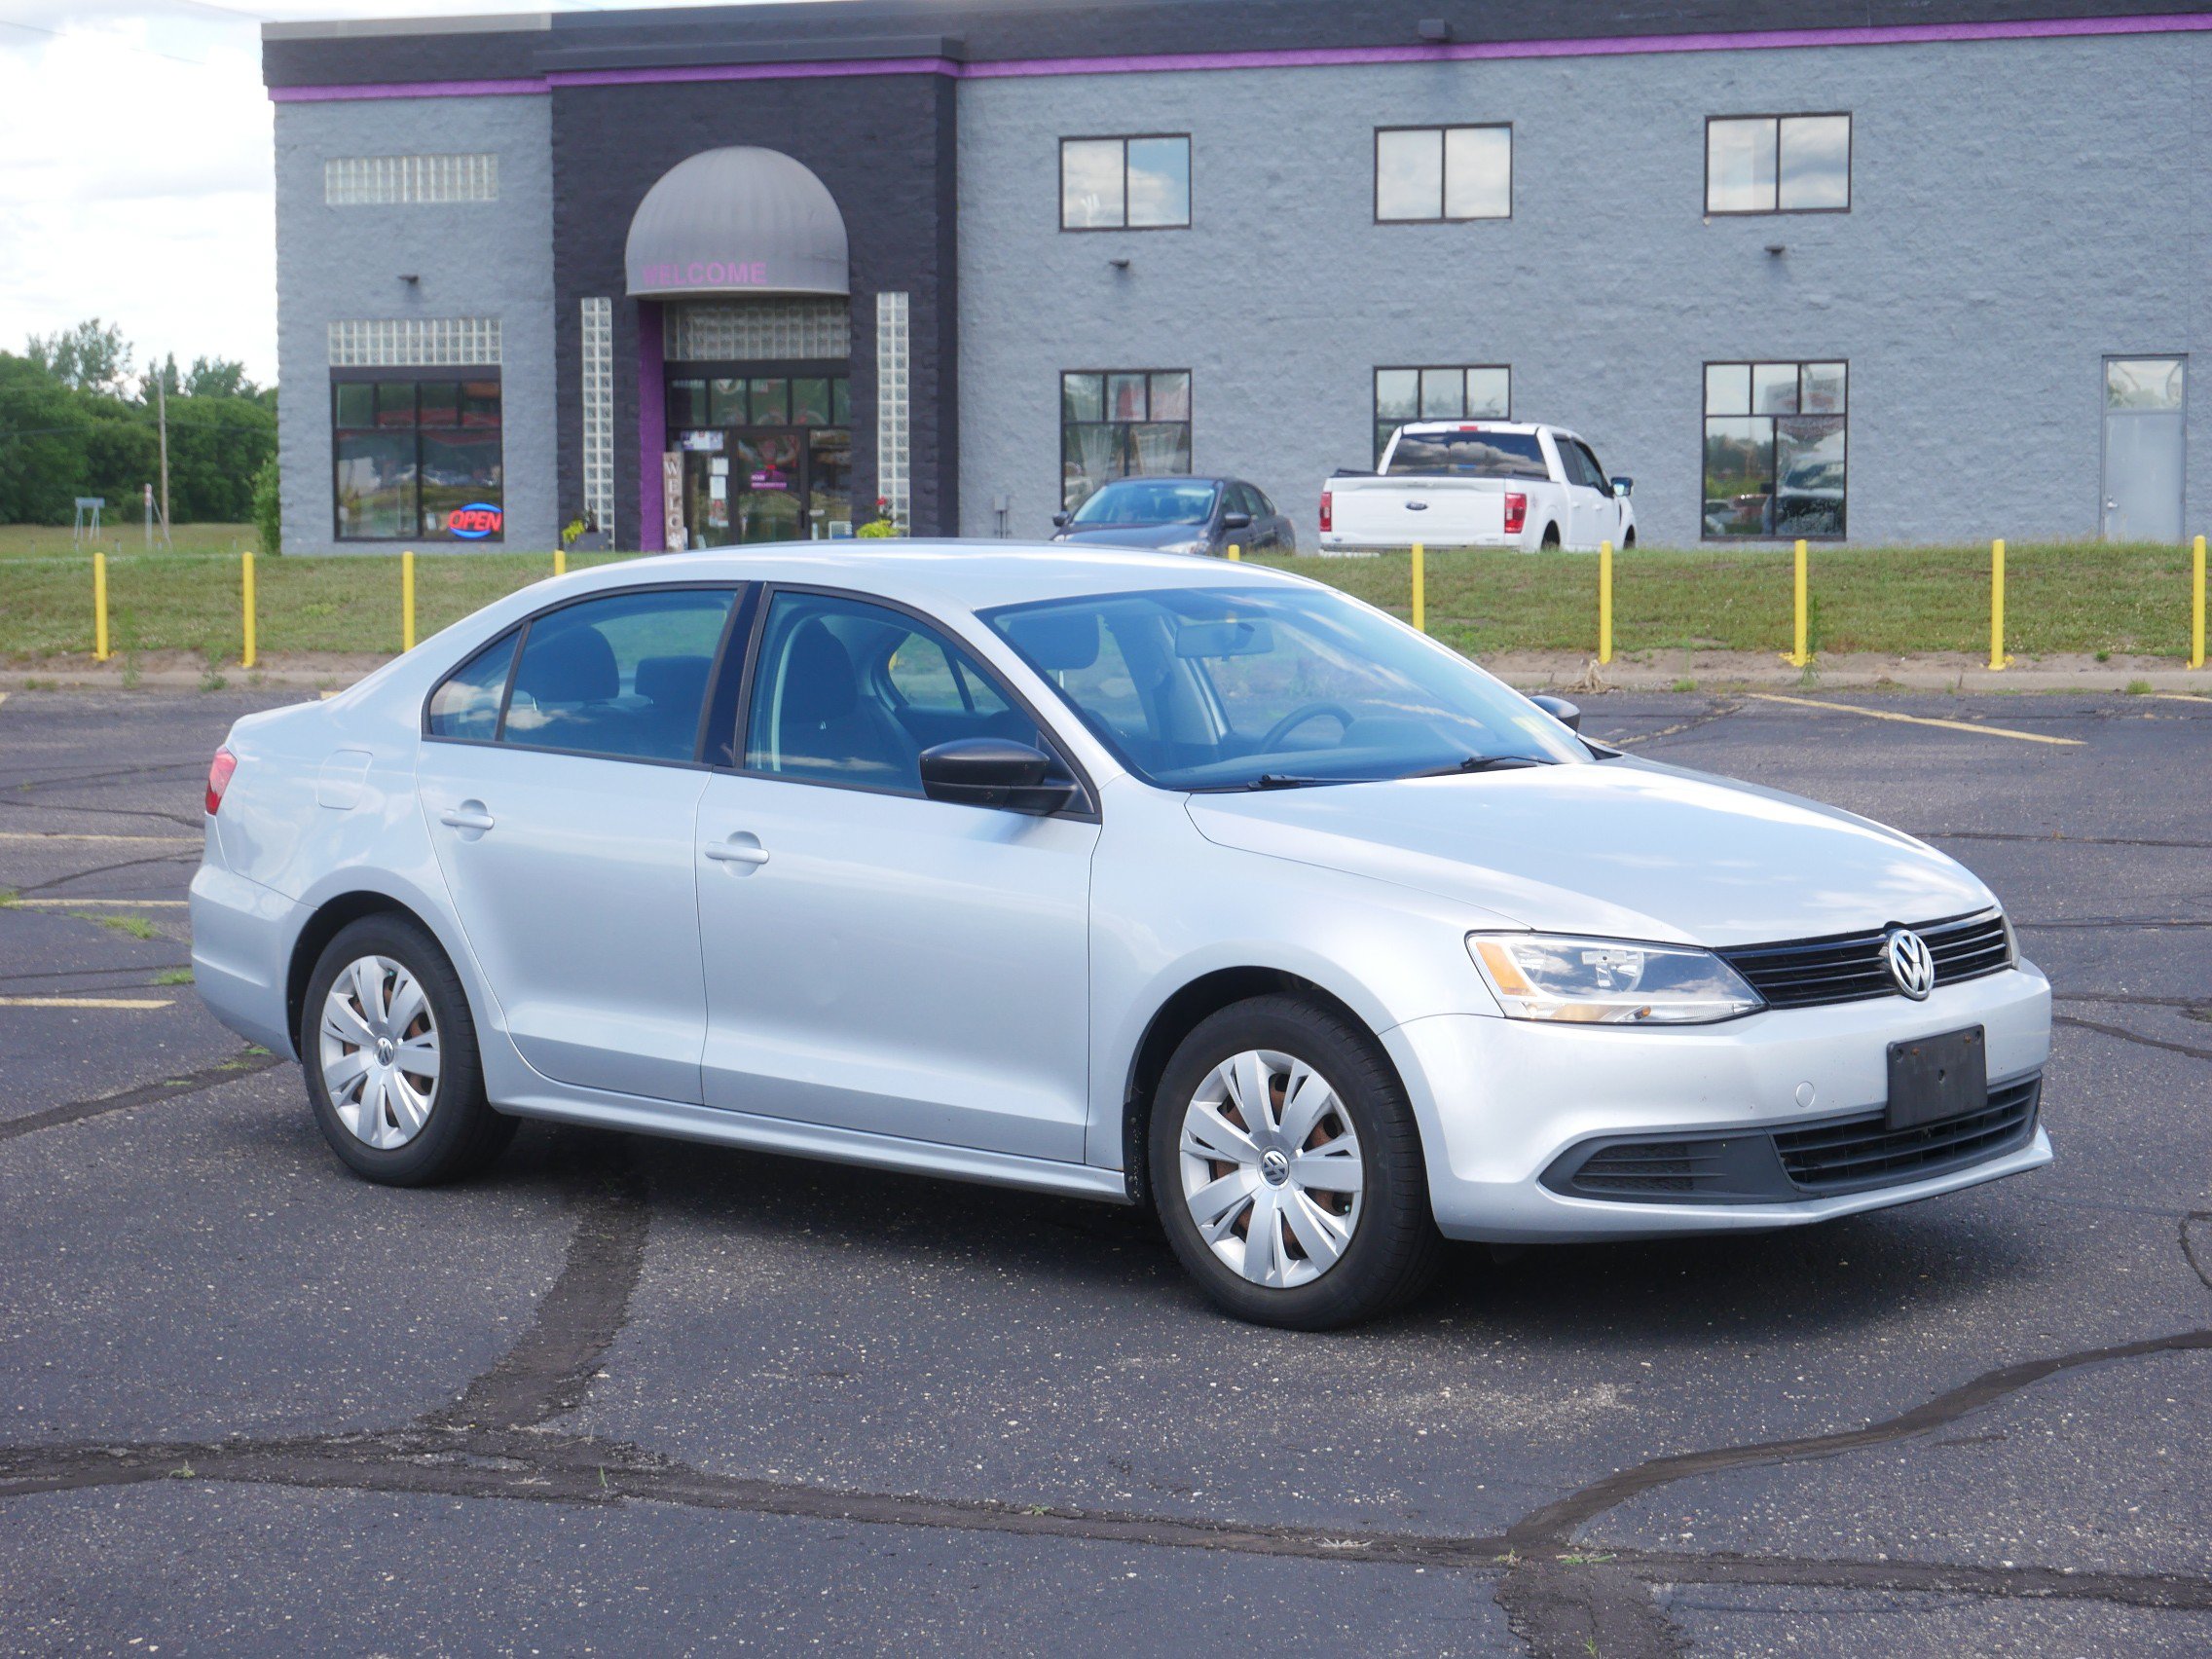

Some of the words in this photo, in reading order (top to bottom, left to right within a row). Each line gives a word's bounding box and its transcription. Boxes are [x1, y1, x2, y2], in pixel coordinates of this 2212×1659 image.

[642, 261, 768, 286] WELCOME
[448, 509, 503, 532] OPEN
[1887, 928, 1936, 1001] VW
